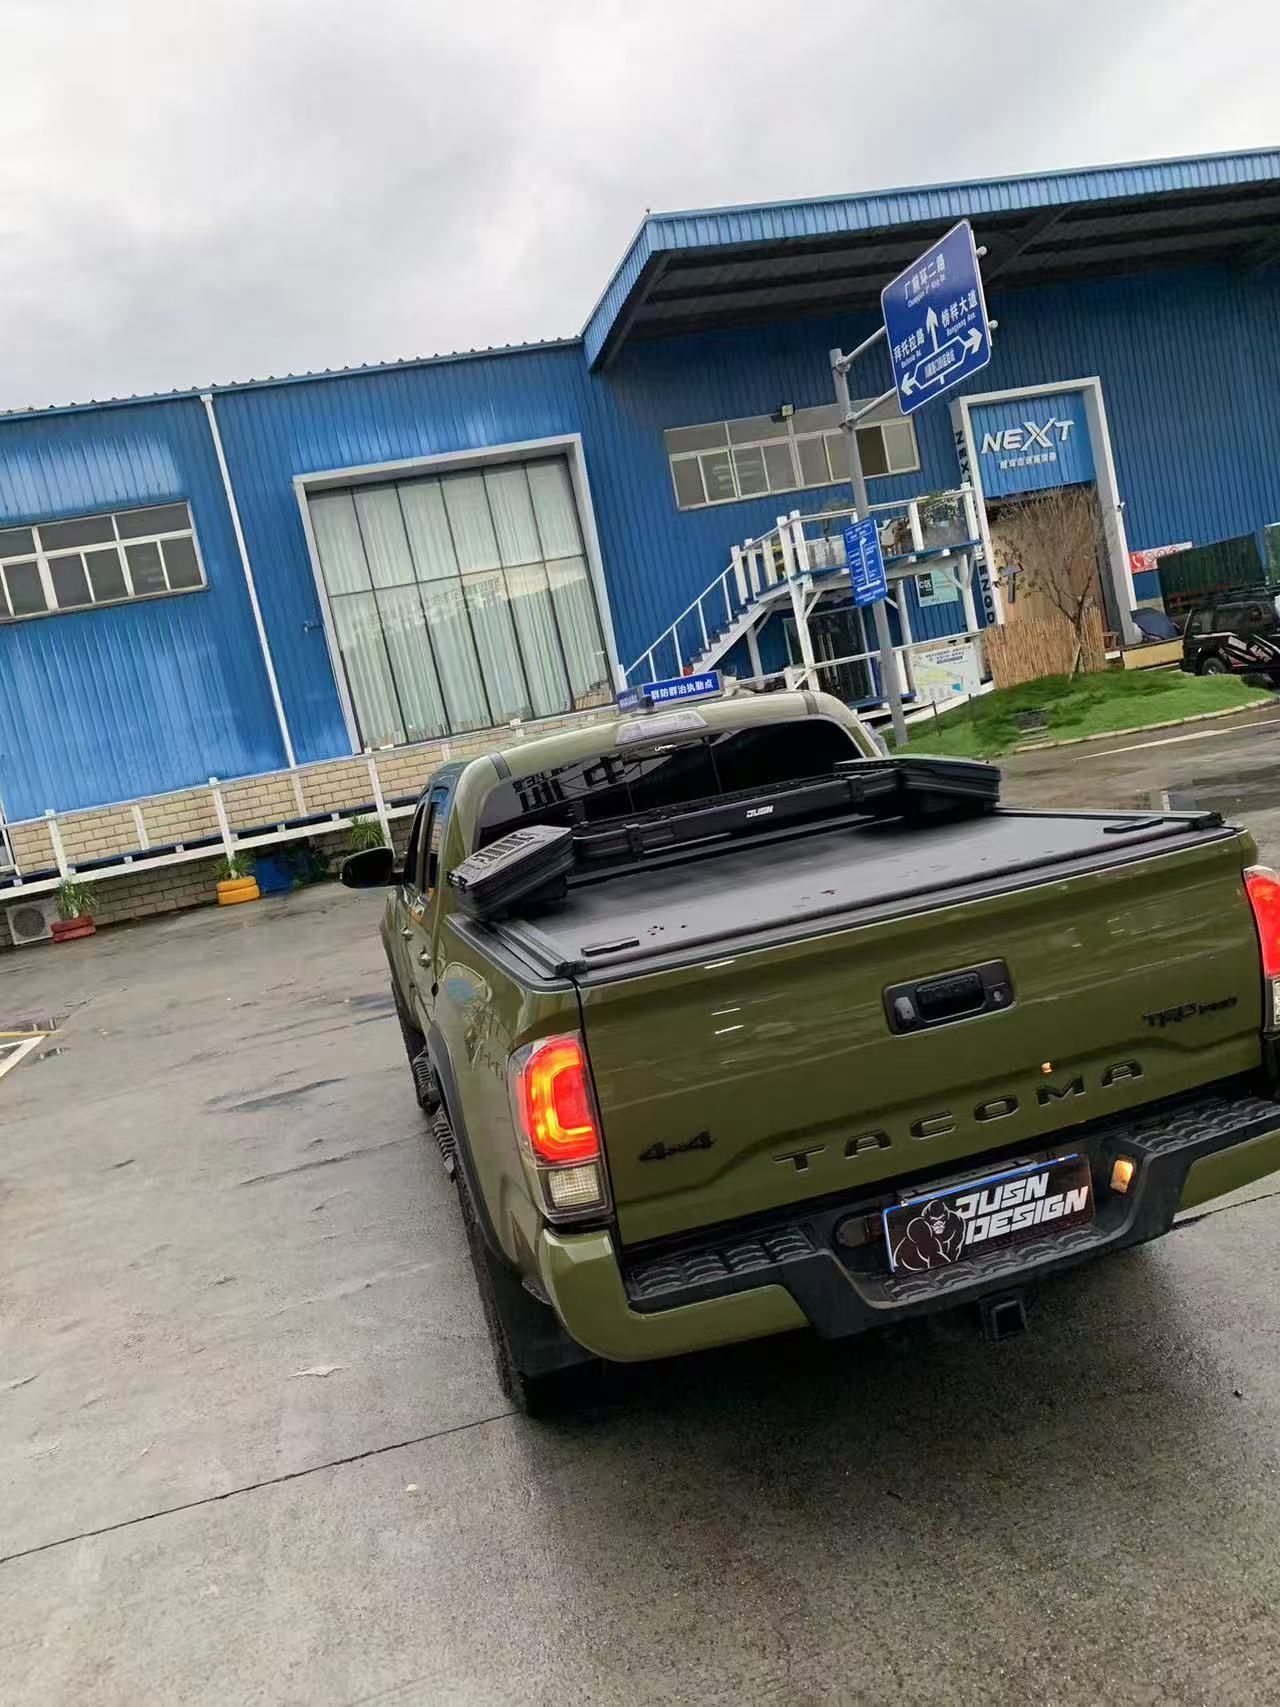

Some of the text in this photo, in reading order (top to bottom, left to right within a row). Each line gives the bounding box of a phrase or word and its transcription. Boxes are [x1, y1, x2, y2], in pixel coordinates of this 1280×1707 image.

[941, 289, 978, 328] 榜样大道
[981, 417, 1075, 454] NEXT
[650, 679, 714, 700] 群防群治执勤点
[772, 1058, 1143, 1172] TACOMA
[965, 1186, 1089, 1245] DESIGN
